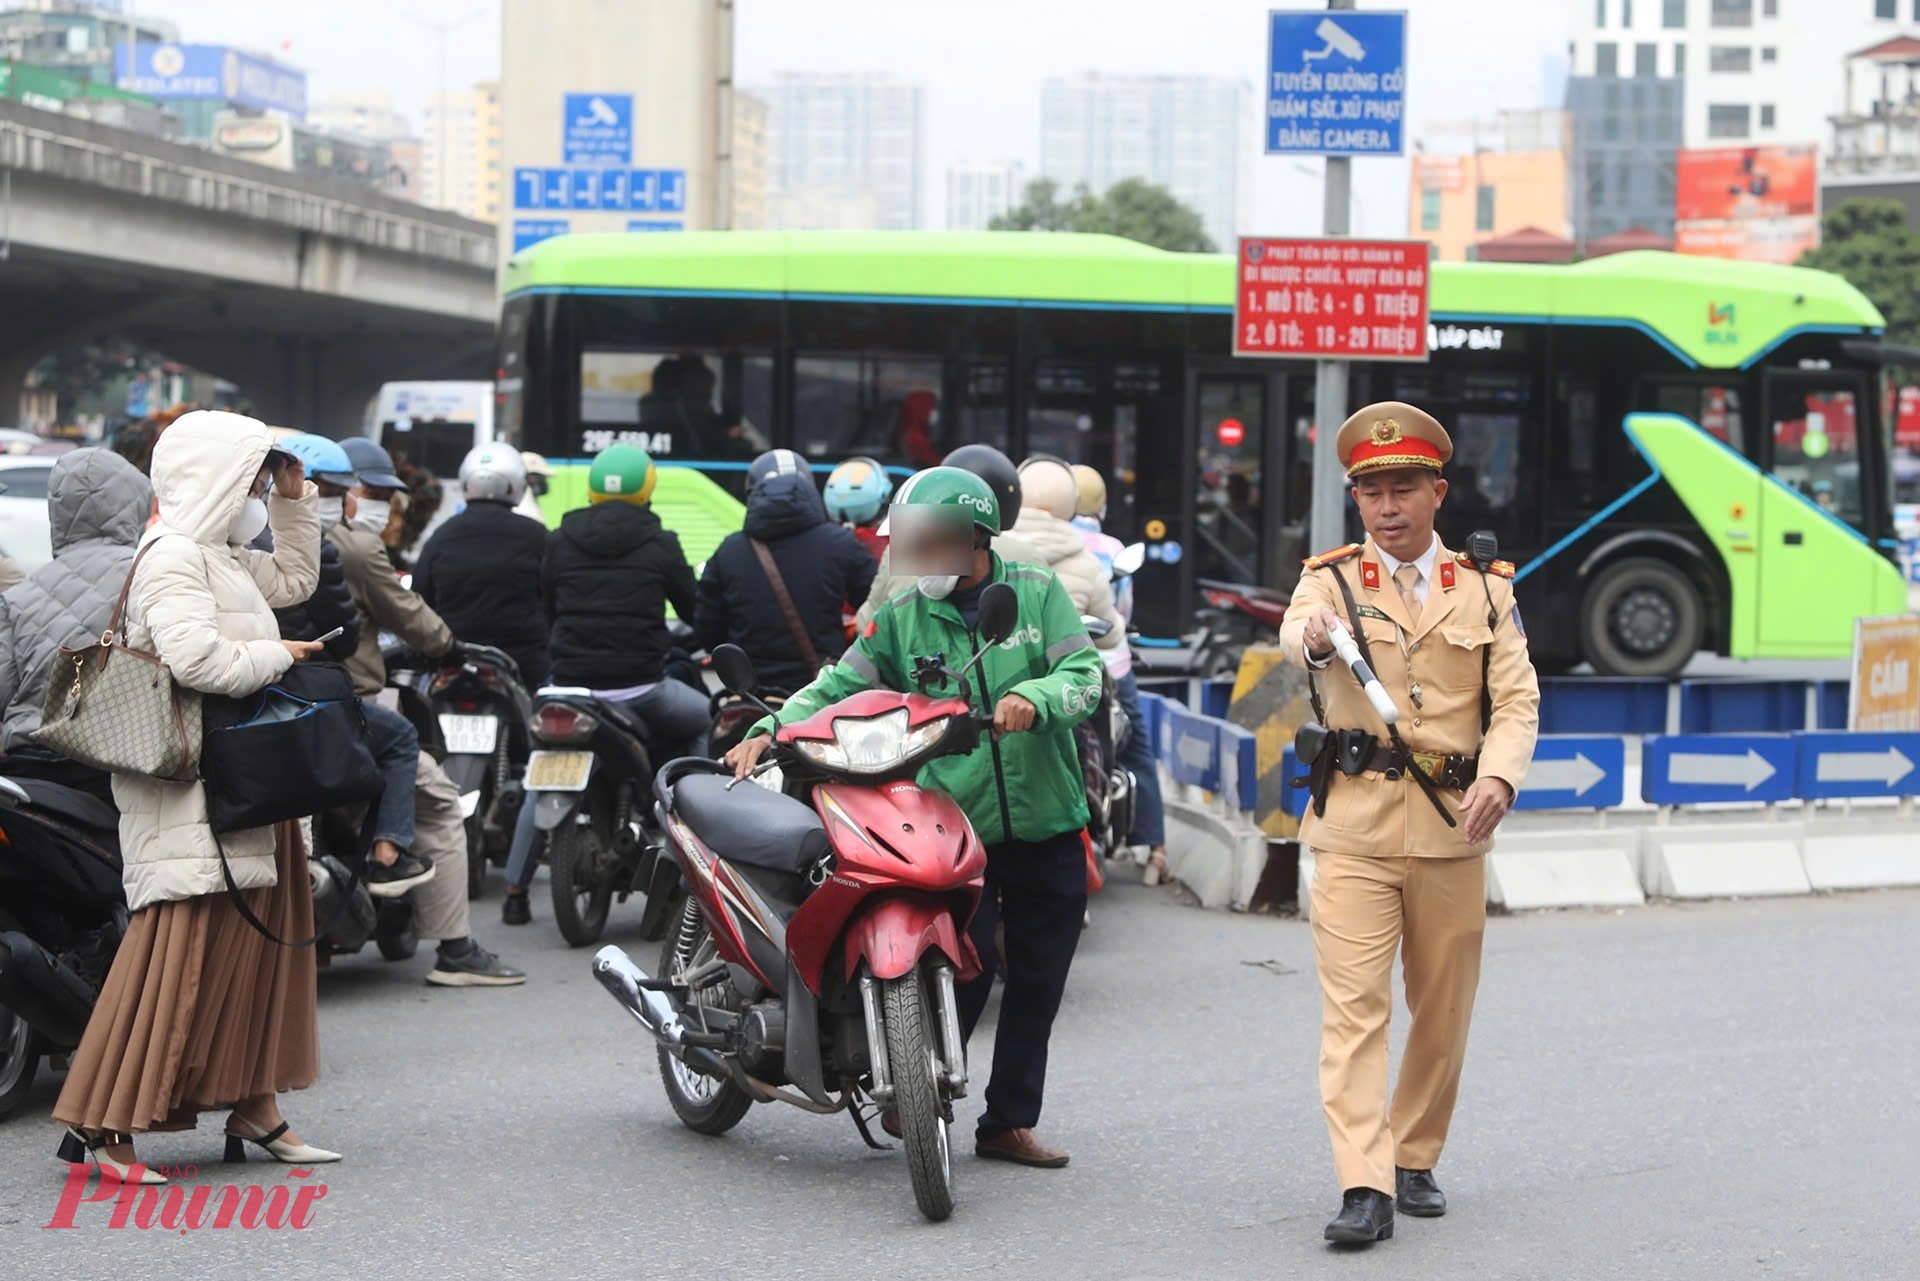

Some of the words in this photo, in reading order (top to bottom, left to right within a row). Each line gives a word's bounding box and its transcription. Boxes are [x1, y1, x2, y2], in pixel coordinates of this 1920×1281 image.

[1273, 64, 1322, 91] TUYẾN
[1323, 129, 1390, 149] CAMERA
[1248, 291, 1262, 312] 1.
[1265, 289, 1291, 313] MÔ
[1323, 293, 1334, 313] 4
[1353, 293, 1364, 315] 6
[1374, 291, 1419, 319] TRIỆU
[1245, 322, 1262, 345] 2.
[1264, 320, 1277, 345] Ô
[1348, 326, 1369, 348] 20
[1372, 324, 1416, 352] TRIỆU
[832, 876, 861, 888] HONDA
